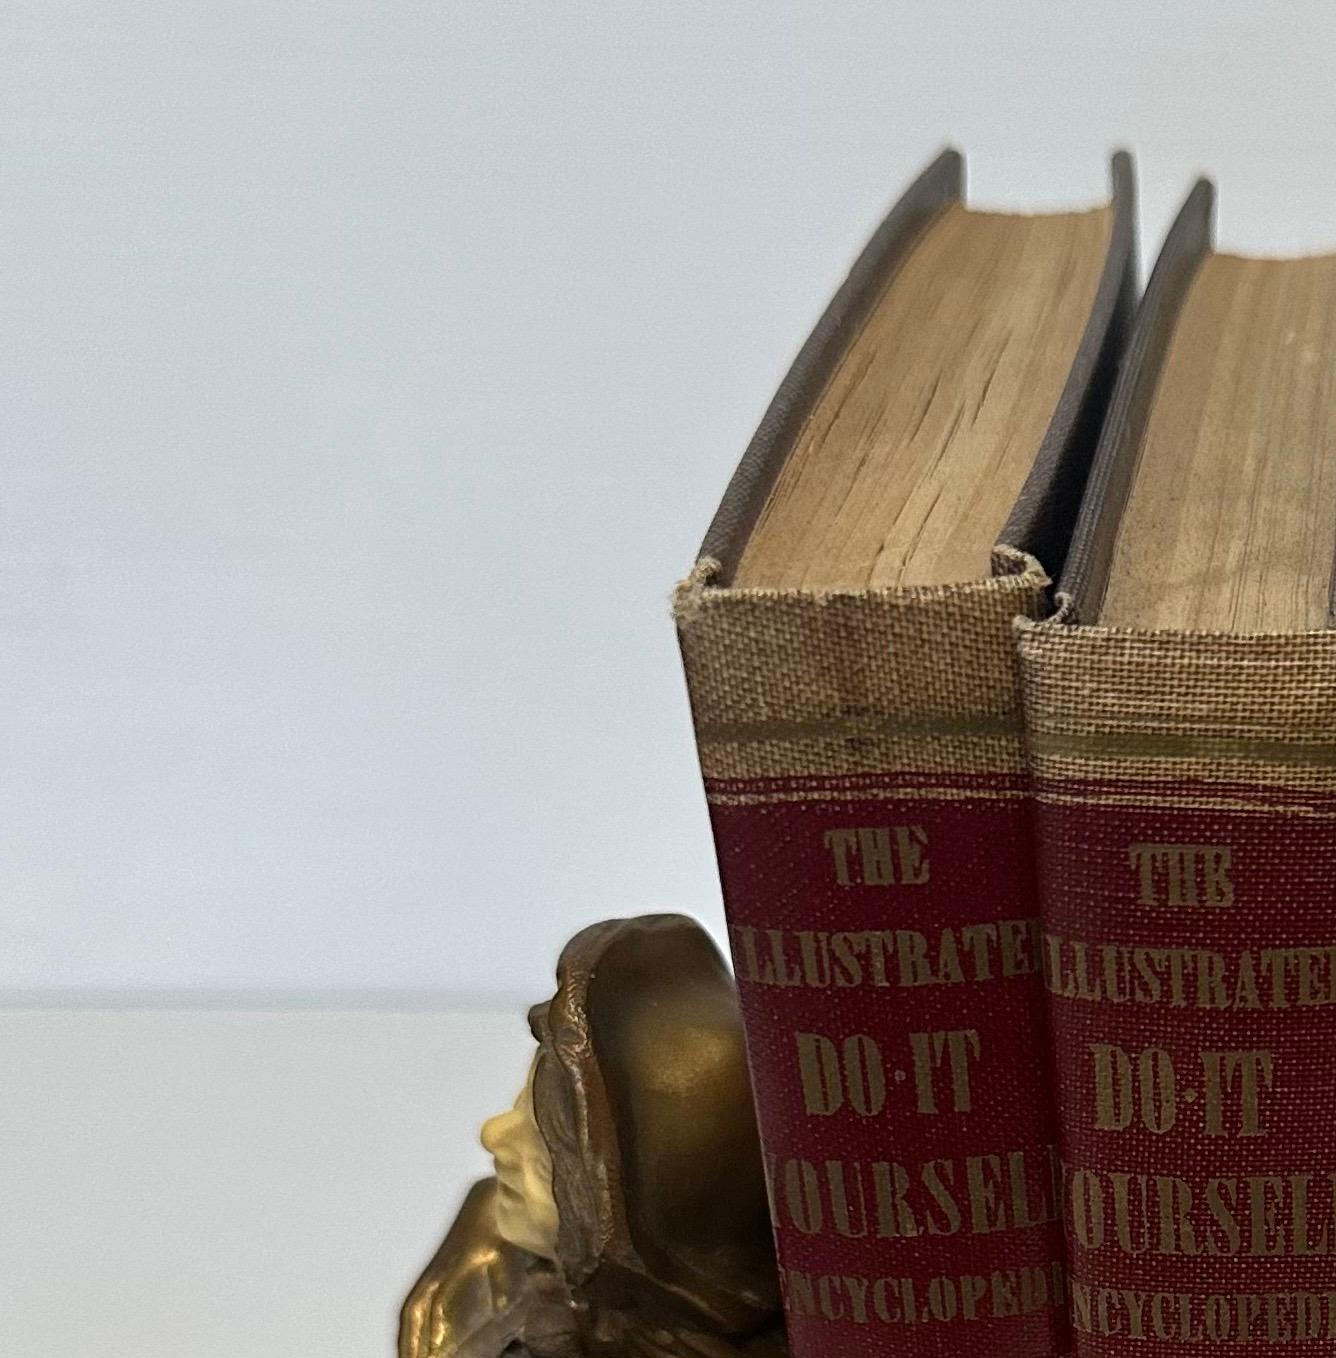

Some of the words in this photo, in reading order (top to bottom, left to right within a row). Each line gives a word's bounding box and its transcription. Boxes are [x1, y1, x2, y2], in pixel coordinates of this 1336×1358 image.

[824, 826, 930, 886] THE
[1129, 843, 1235, 907] THE
[731, 918, 1041, 987] LLUSTRATE
[764, 1145, 1063, 1238] OURSEL
[782, 1262, 1063, 1324] NCYCLOPEDI
